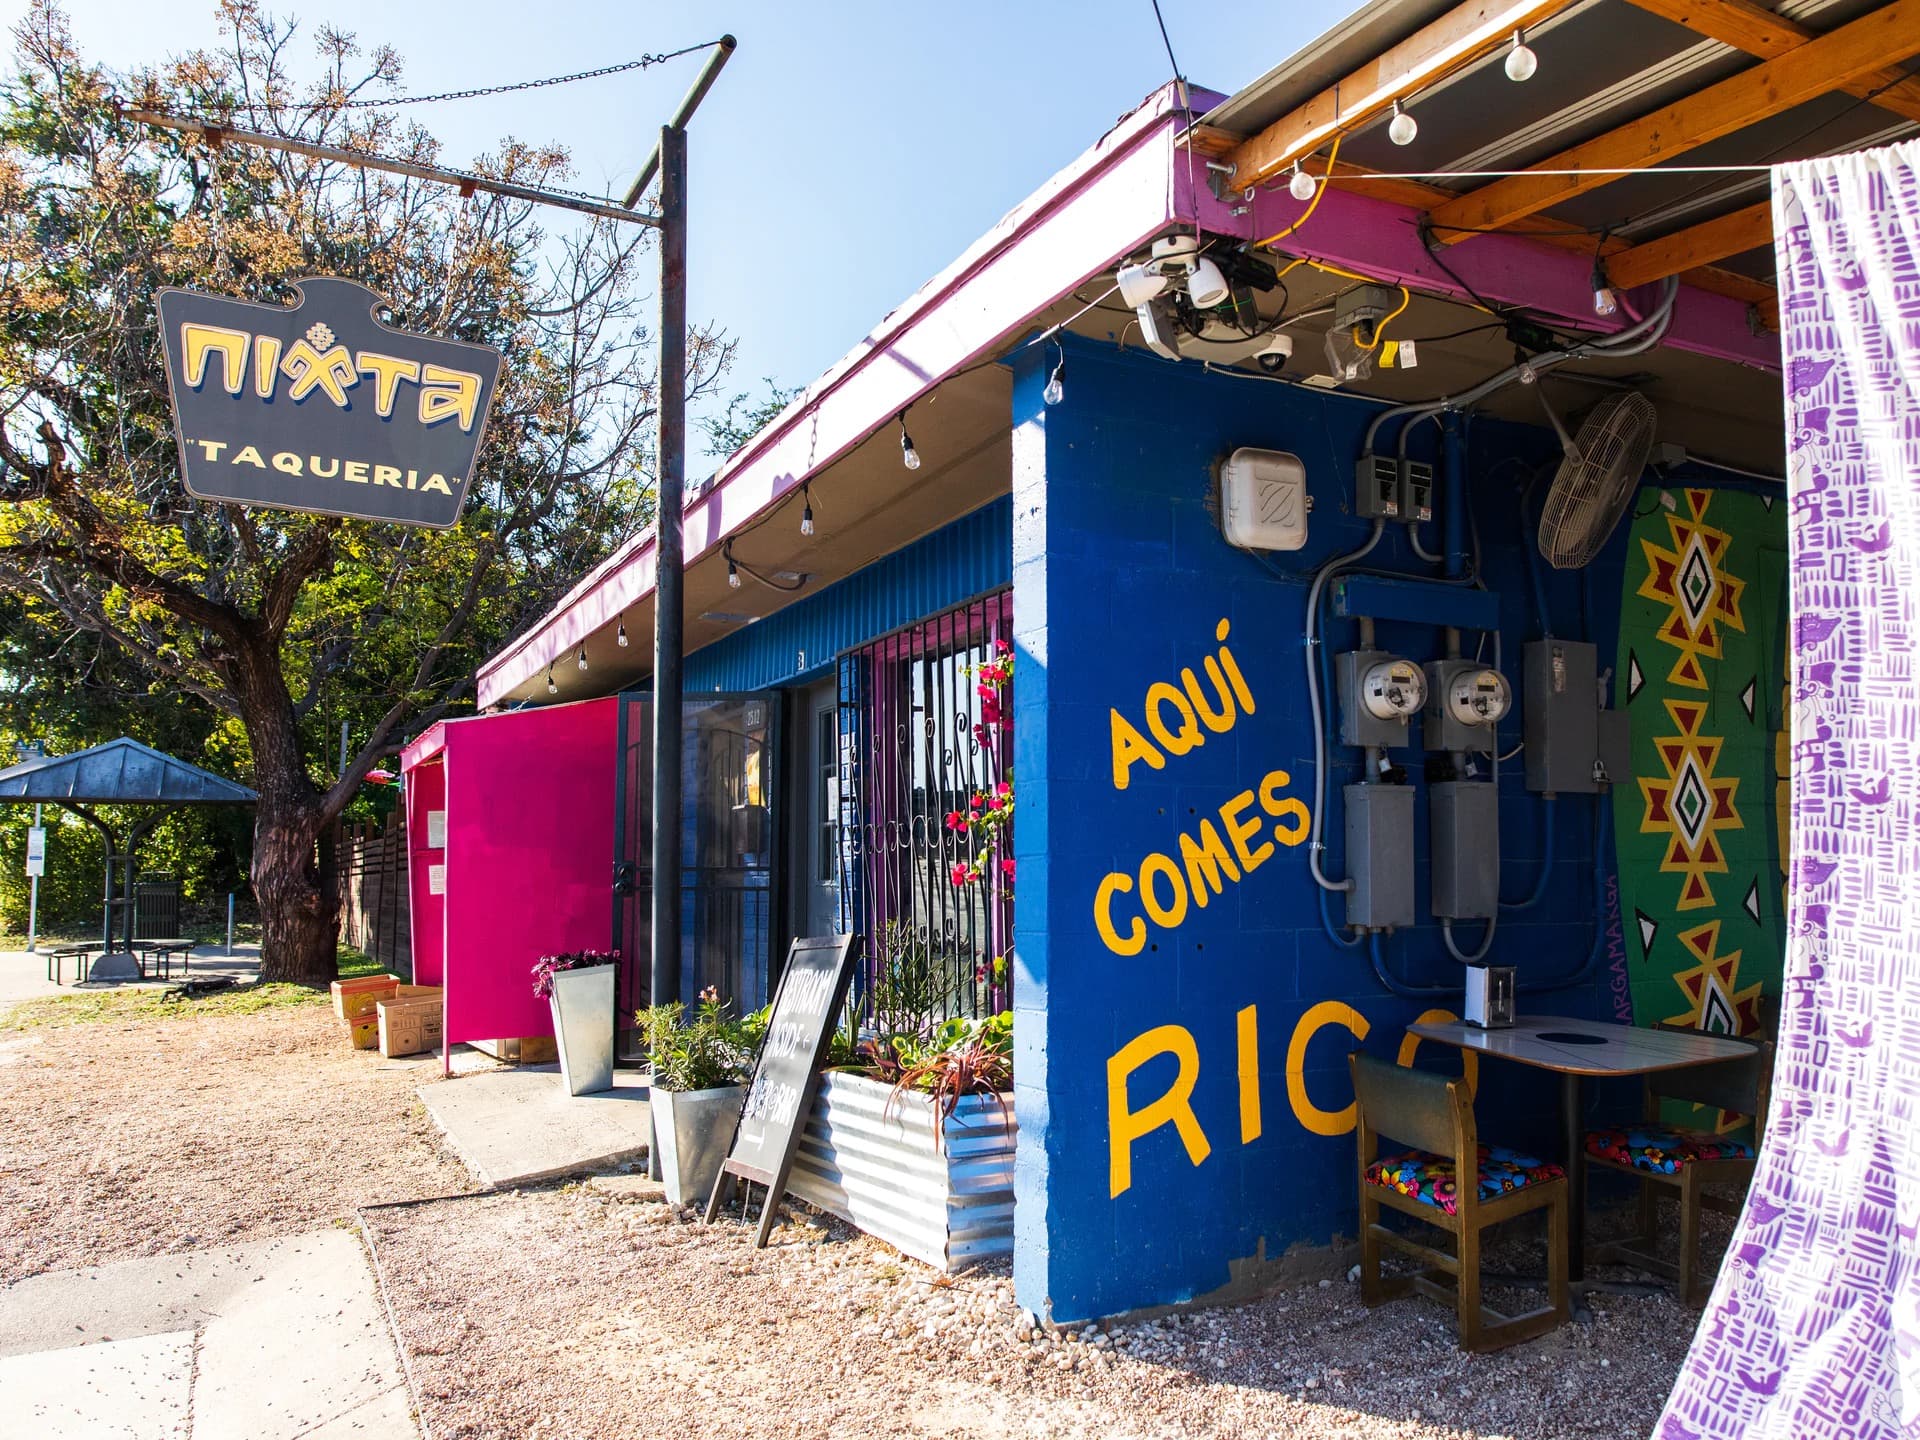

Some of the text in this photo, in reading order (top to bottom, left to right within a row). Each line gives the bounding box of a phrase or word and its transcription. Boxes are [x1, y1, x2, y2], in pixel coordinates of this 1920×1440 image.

[1094, 770, 1310, 956] COMES
[778, 968, 834, 1017] RESTROOM
[1606, 874, 1633, 1026] ARGAMANGA
